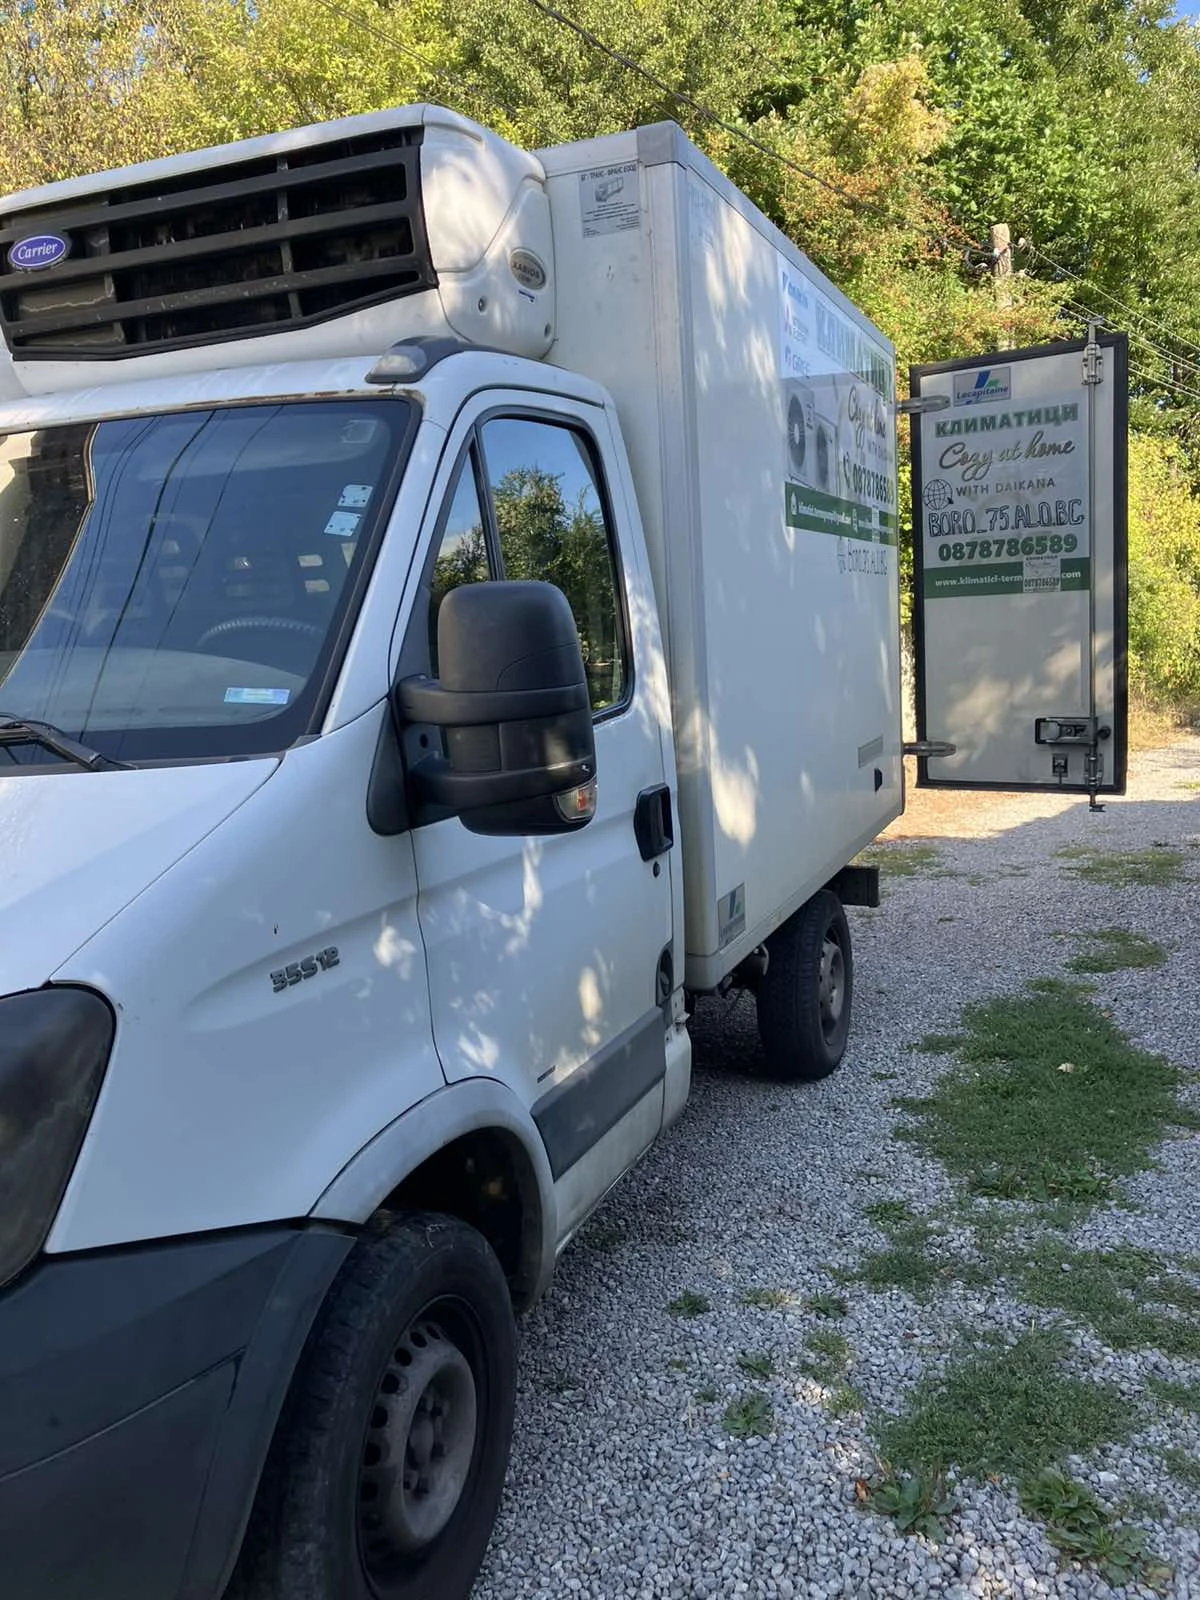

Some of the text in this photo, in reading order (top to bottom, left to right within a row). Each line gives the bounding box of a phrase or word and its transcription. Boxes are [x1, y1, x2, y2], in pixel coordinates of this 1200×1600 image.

[18, 242, 58, 260] Carrier
[956, 386, 1009, 400] Lacapitaine
[938, 429, 1076, 481] Cozy at home
[956, 478, 1056, 497] WITH DAIKANA
[937, 532, 1079, 562] 0878786589
[270, 946, 340, 993] 35S12
